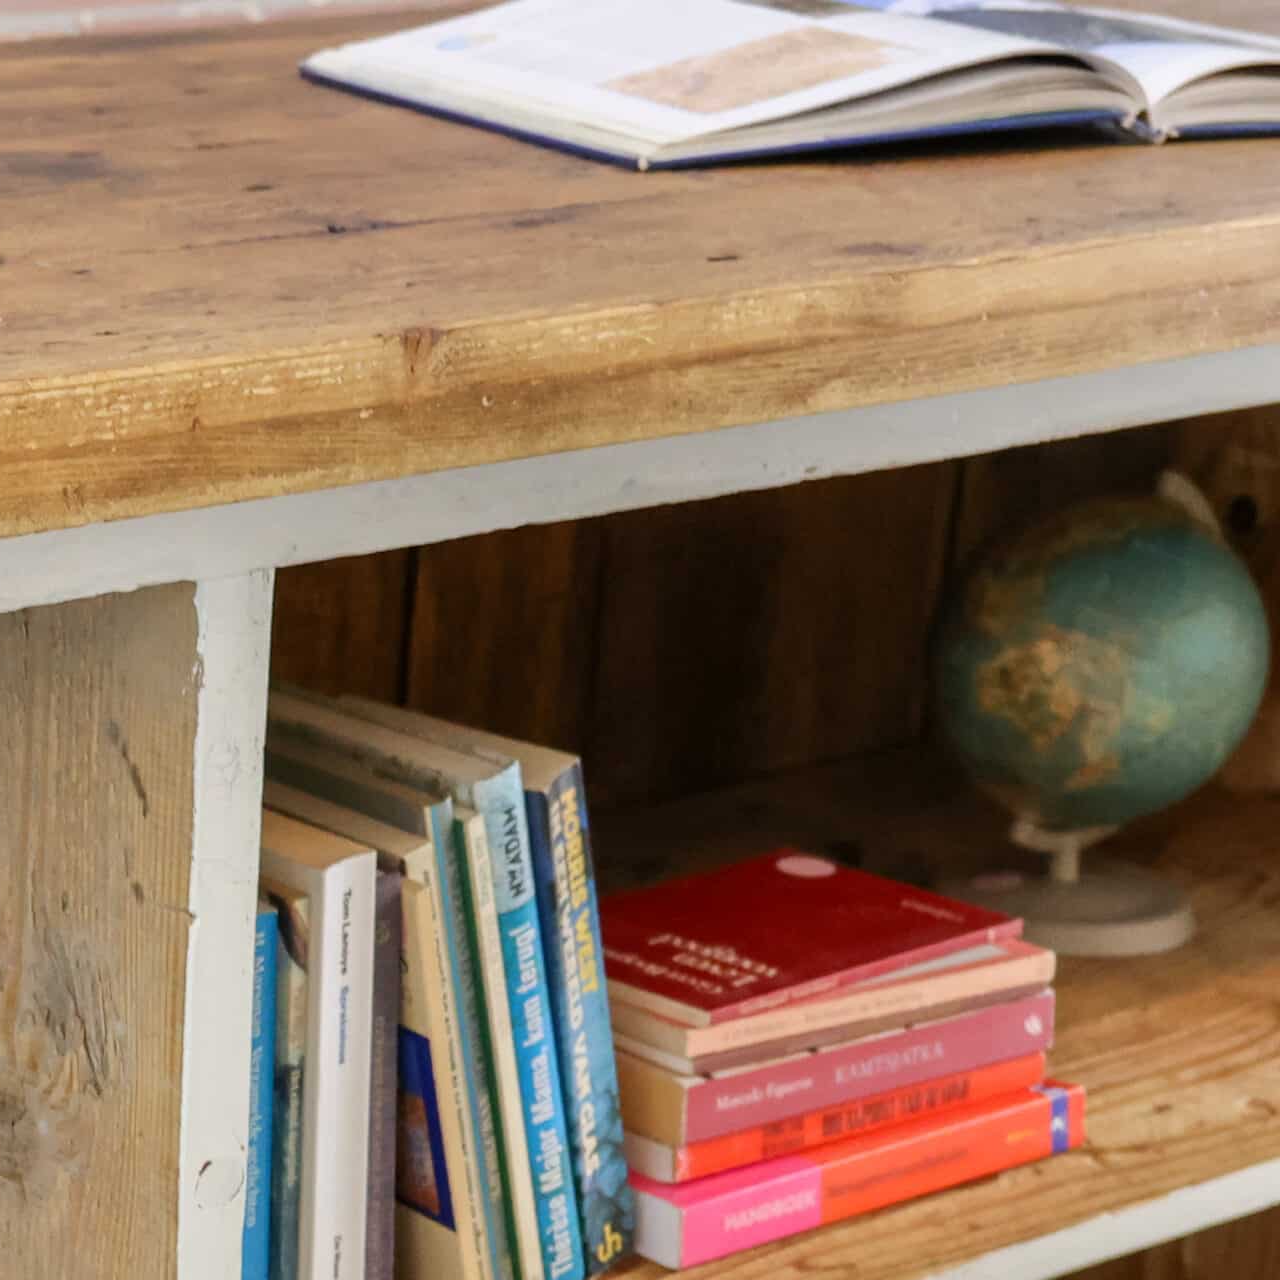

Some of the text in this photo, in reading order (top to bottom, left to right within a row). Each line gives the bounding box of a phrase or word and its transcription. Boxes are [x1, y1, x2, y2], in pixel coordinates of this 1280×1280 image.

[561, 787, 599, 993] MORRIS WEST
[508, 921, 554, 1125] Mama, kom terug!
[573, 1031, 592, 1099] VAN
[536, 1127, 563, 1194] Major
[579, 1101, 600, 1178] GLAS
